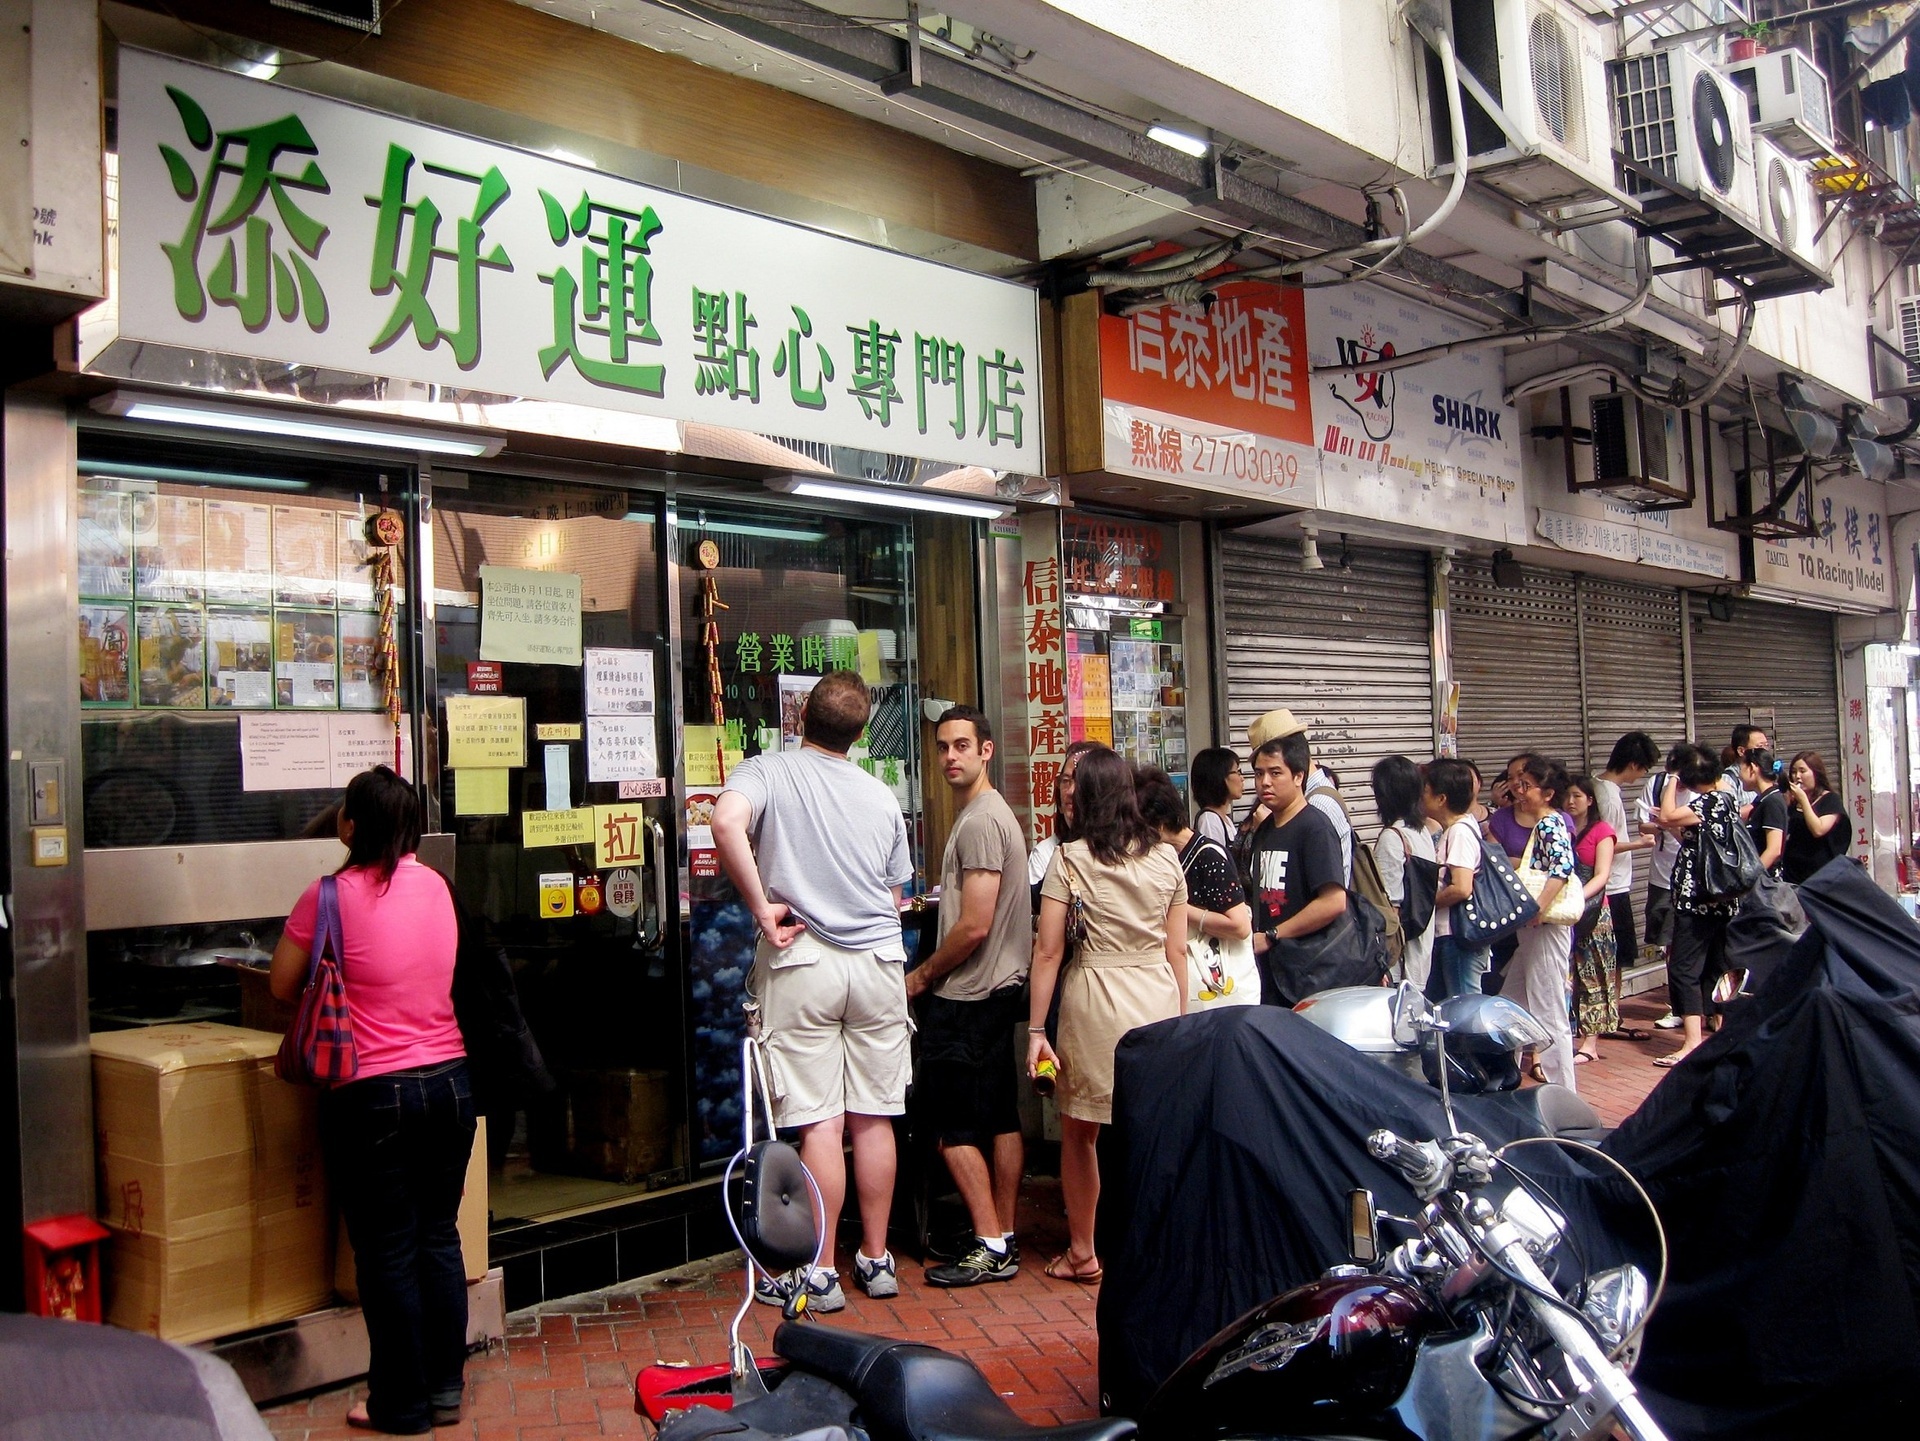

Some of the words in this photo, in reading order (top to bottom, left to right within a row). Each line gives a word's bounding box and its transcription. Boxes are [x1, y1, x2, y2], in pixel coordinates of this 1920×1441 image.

[158, 84, 664, 398] 添好運
[691, 285, 1026, 449] 點心專門店
[1128, 292, 1296, 412] 信泰地產
[1432, 394, 1503, 441] SHARK
[1131, 419, 1184, 474] 熱線
[1191, 434, 1298, 489] 27703039
[1456, 465, 1496, 489] SPECIALTY
[1497, 475, 1516, 494] SHOP
[1765, 549, 1790, 568] TAMIYA
[1798, 553, 1815, 580] TQ
[1817, 557, 1854, 592] Racing
[1855, 567, 1885, 593] Model
[736, 632, 858, 674] 營業時間
[622, 782, 662, 796] 小心玻璃
[603, 812, 641, 863] 拉
[613, 890, 634, 904] 食肆
